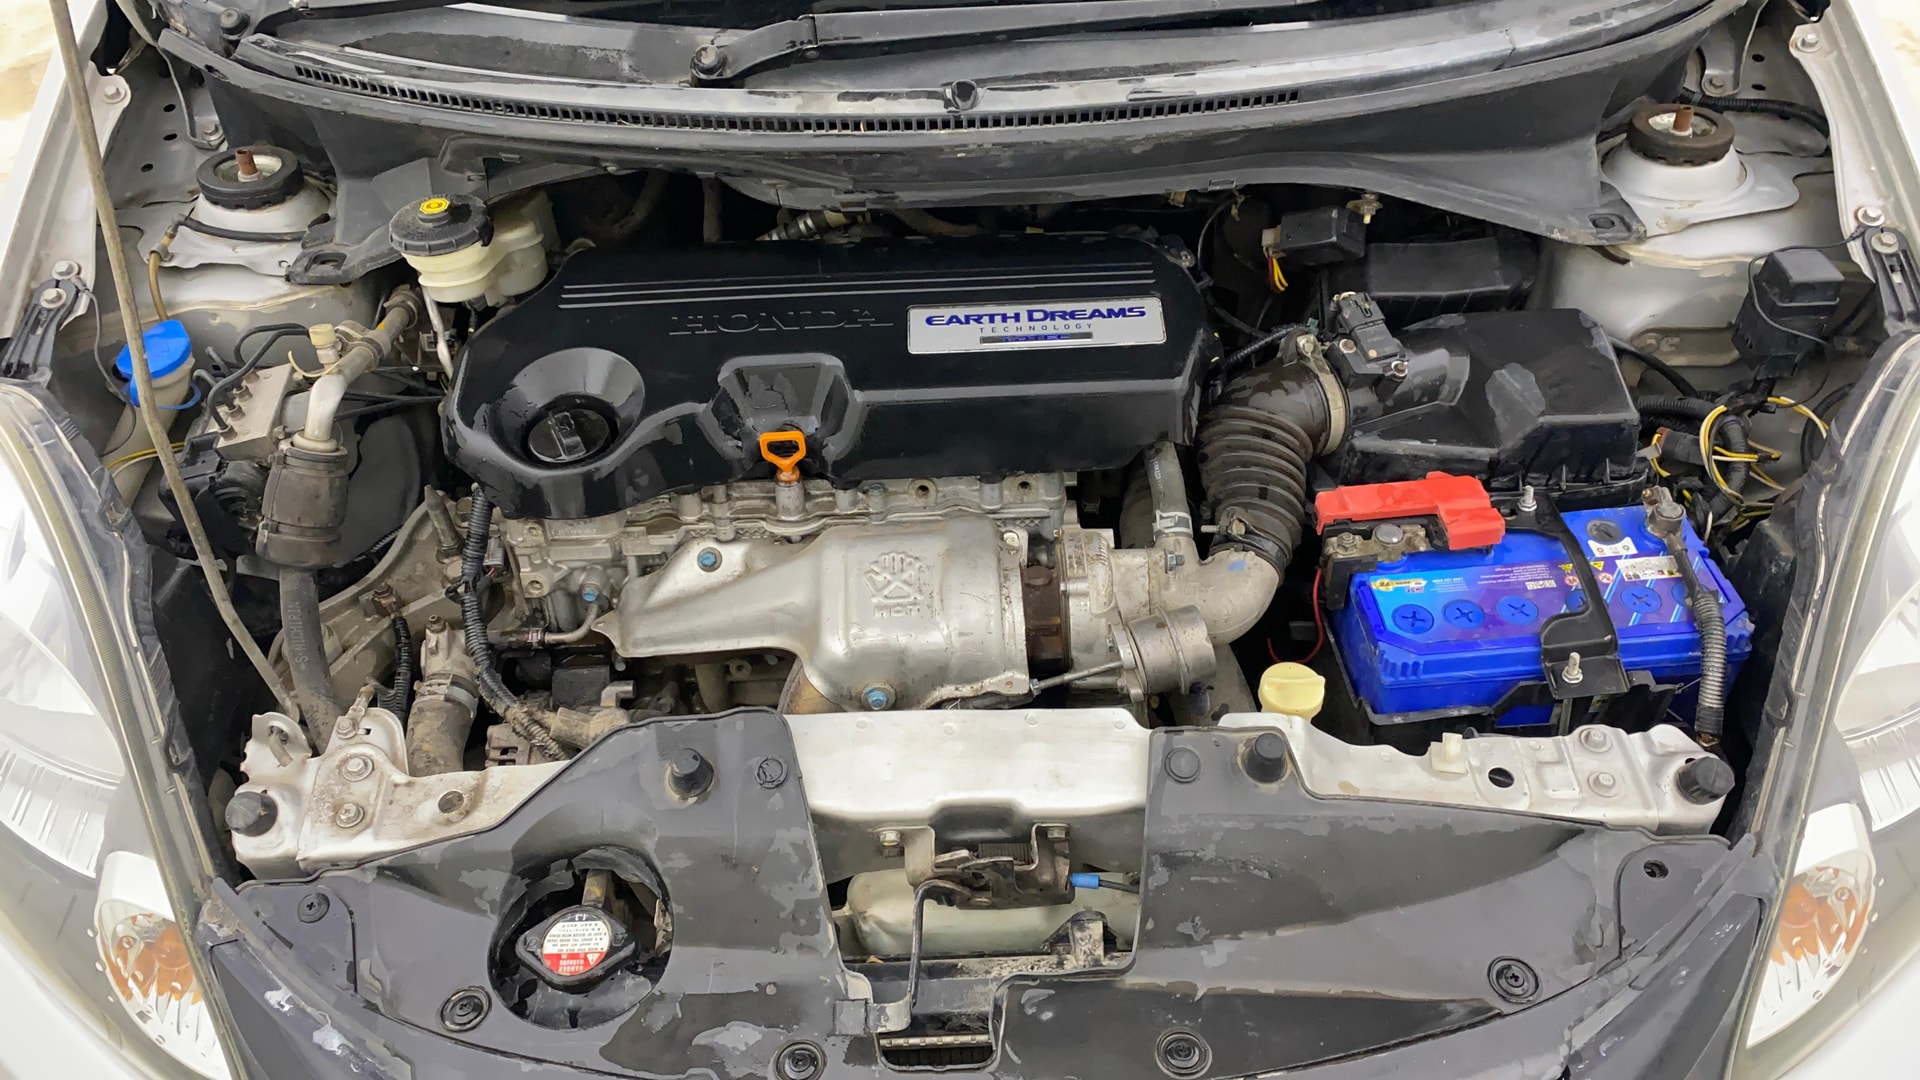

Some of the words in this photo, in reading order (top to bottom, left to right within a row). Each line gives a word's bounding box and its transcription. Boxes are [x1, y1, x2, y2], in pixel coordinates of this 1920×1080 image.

[669, 309, 894, 335] HONDA
[925, 312, 1021, 326] EARTH
[1027, 306, 1147, 324] DREAMS
[979, 323, 1093, 334] TECHNOLOGY
